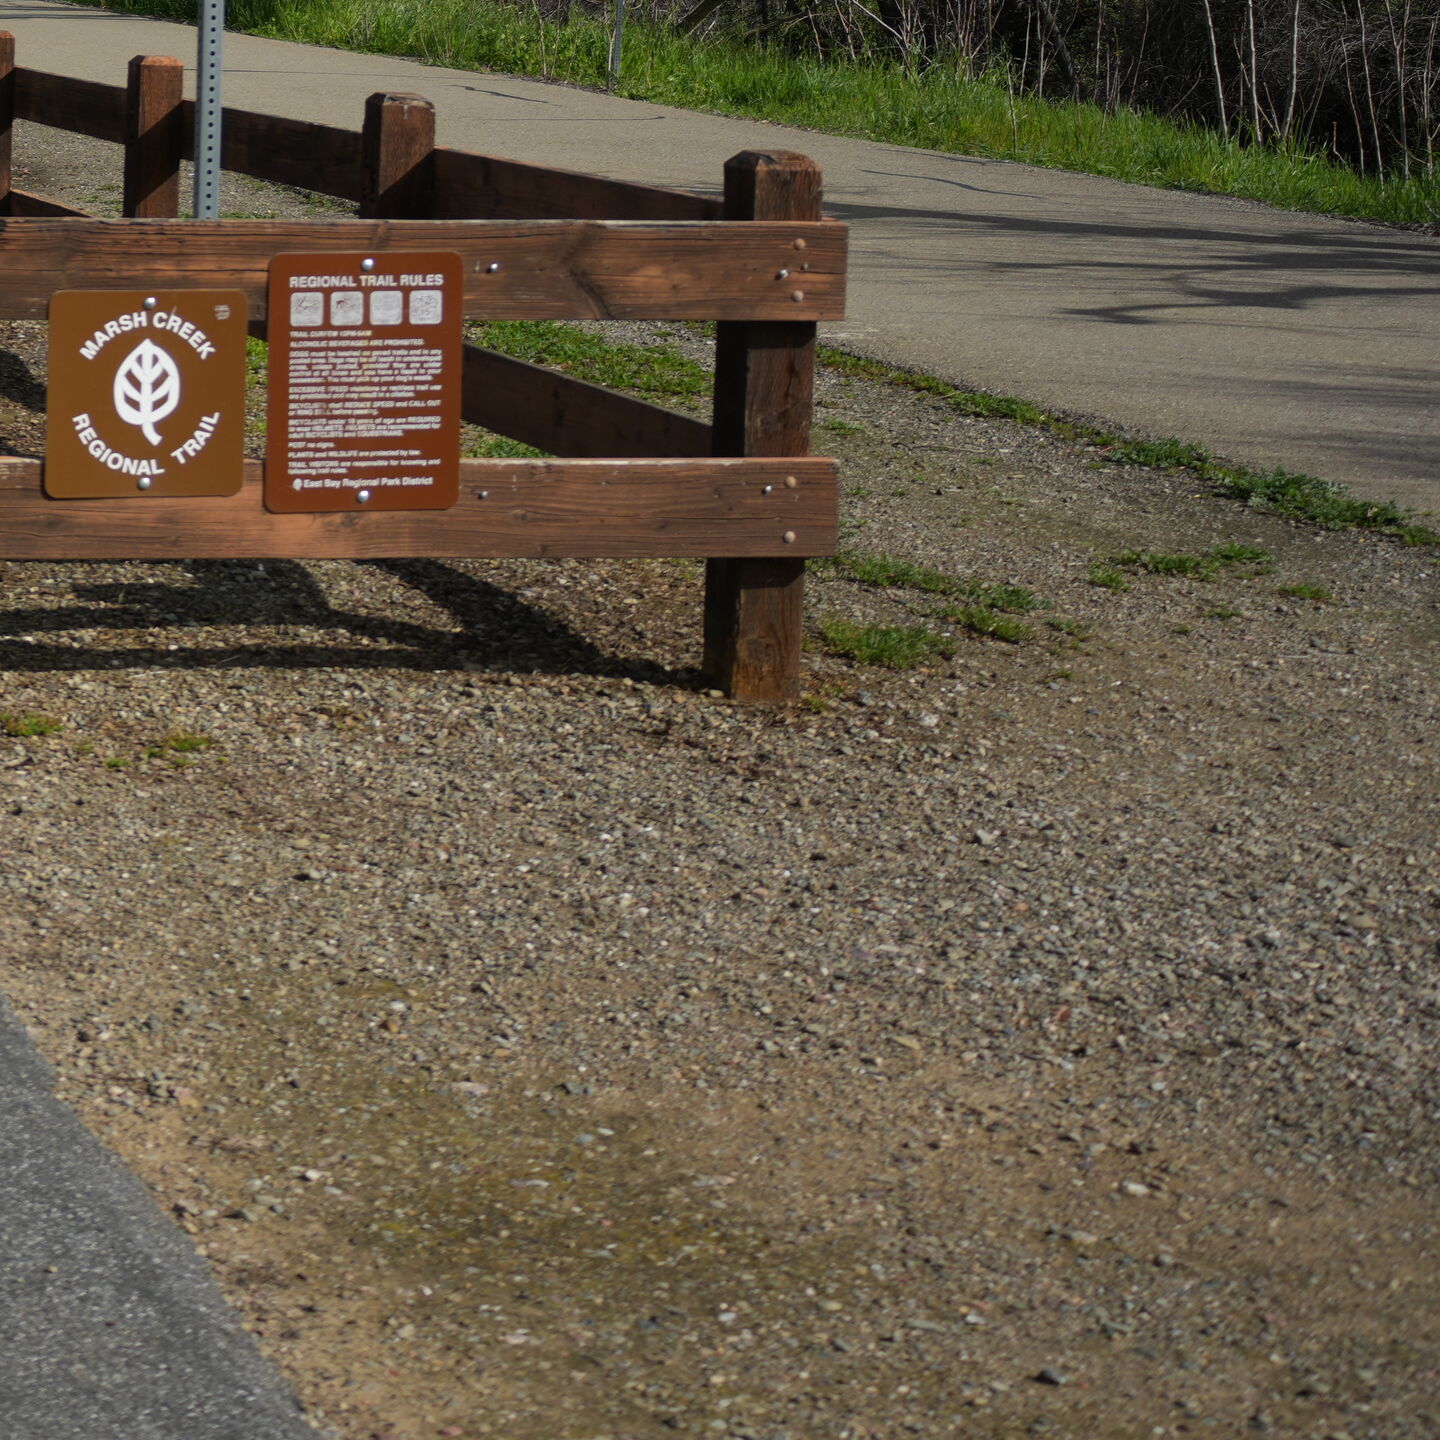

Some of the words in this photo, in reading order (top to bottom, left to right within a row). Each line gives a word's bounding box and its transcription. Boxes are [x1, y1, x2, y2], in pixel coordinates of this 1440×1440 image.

[289, 275, 356, 288] REGIONAL
[359, 274, 397, 287] TRAIL
[400, 274, 444, 286] RULES
[79, 311, 147, 360] MARSH
[152, 312, 216, 360] CREEK
[72, 413, 165, 475] REGIONAL
[170, 412, 220, 464] TRAIL
[304, 479, 323, 487] East
[324, 478, 340, 488] Bay
[342, 478, 379, 488] Regional
[381, 478, 400, 486] Park
[402, 477, 434, 486] District
